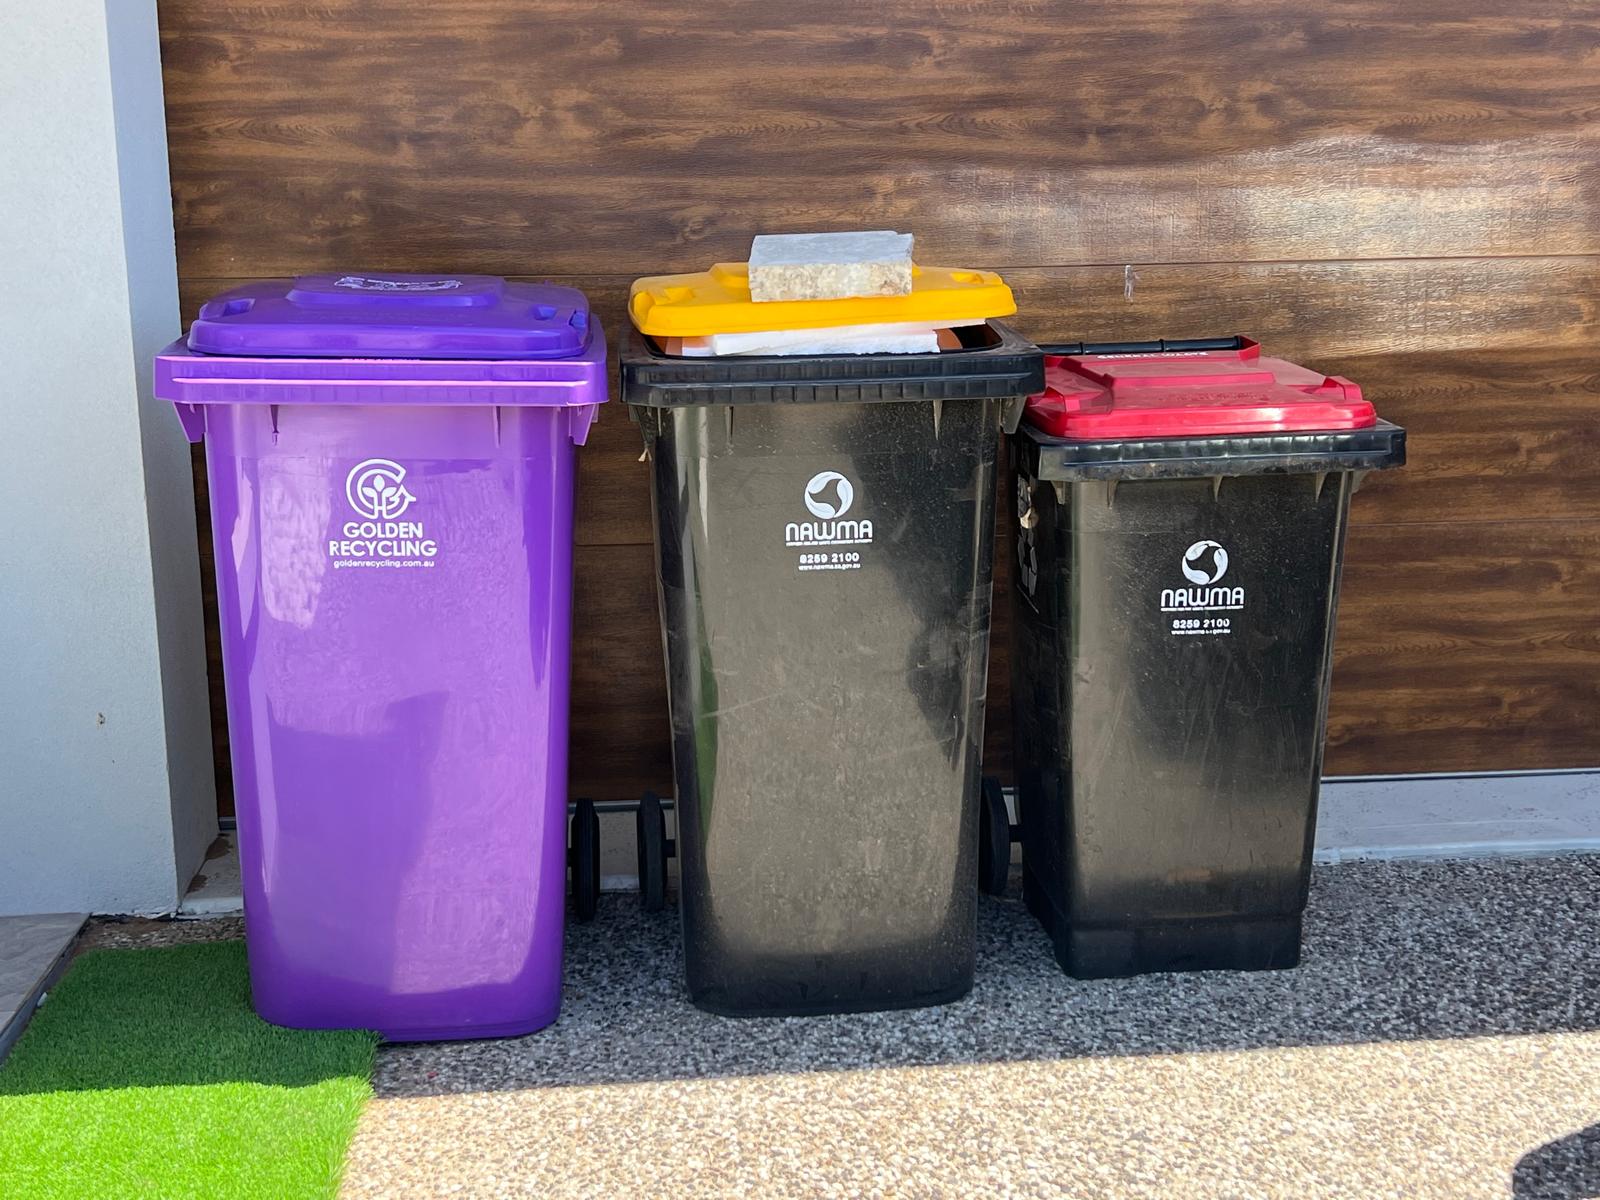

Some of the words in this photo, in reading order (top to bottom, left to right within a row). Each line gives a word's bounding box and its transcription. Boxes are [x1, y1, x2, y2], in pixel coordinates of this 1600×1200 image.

[343, 521, 423, 539] GOLDEN
[785, 520, 873, 541] NAWMA
[328, 540, 438, 557] RECYCLING
[333, 559, 435, 569] goldenrecycling.com.au
[799, 553, 828, 564] 8259
[831, 552, 860, 563] 2100
[1160, 587, 1245, 607] NAWMA
[1172, 619, 1201, 629] 8259
[1203, 618, 1230, 628] 2100
